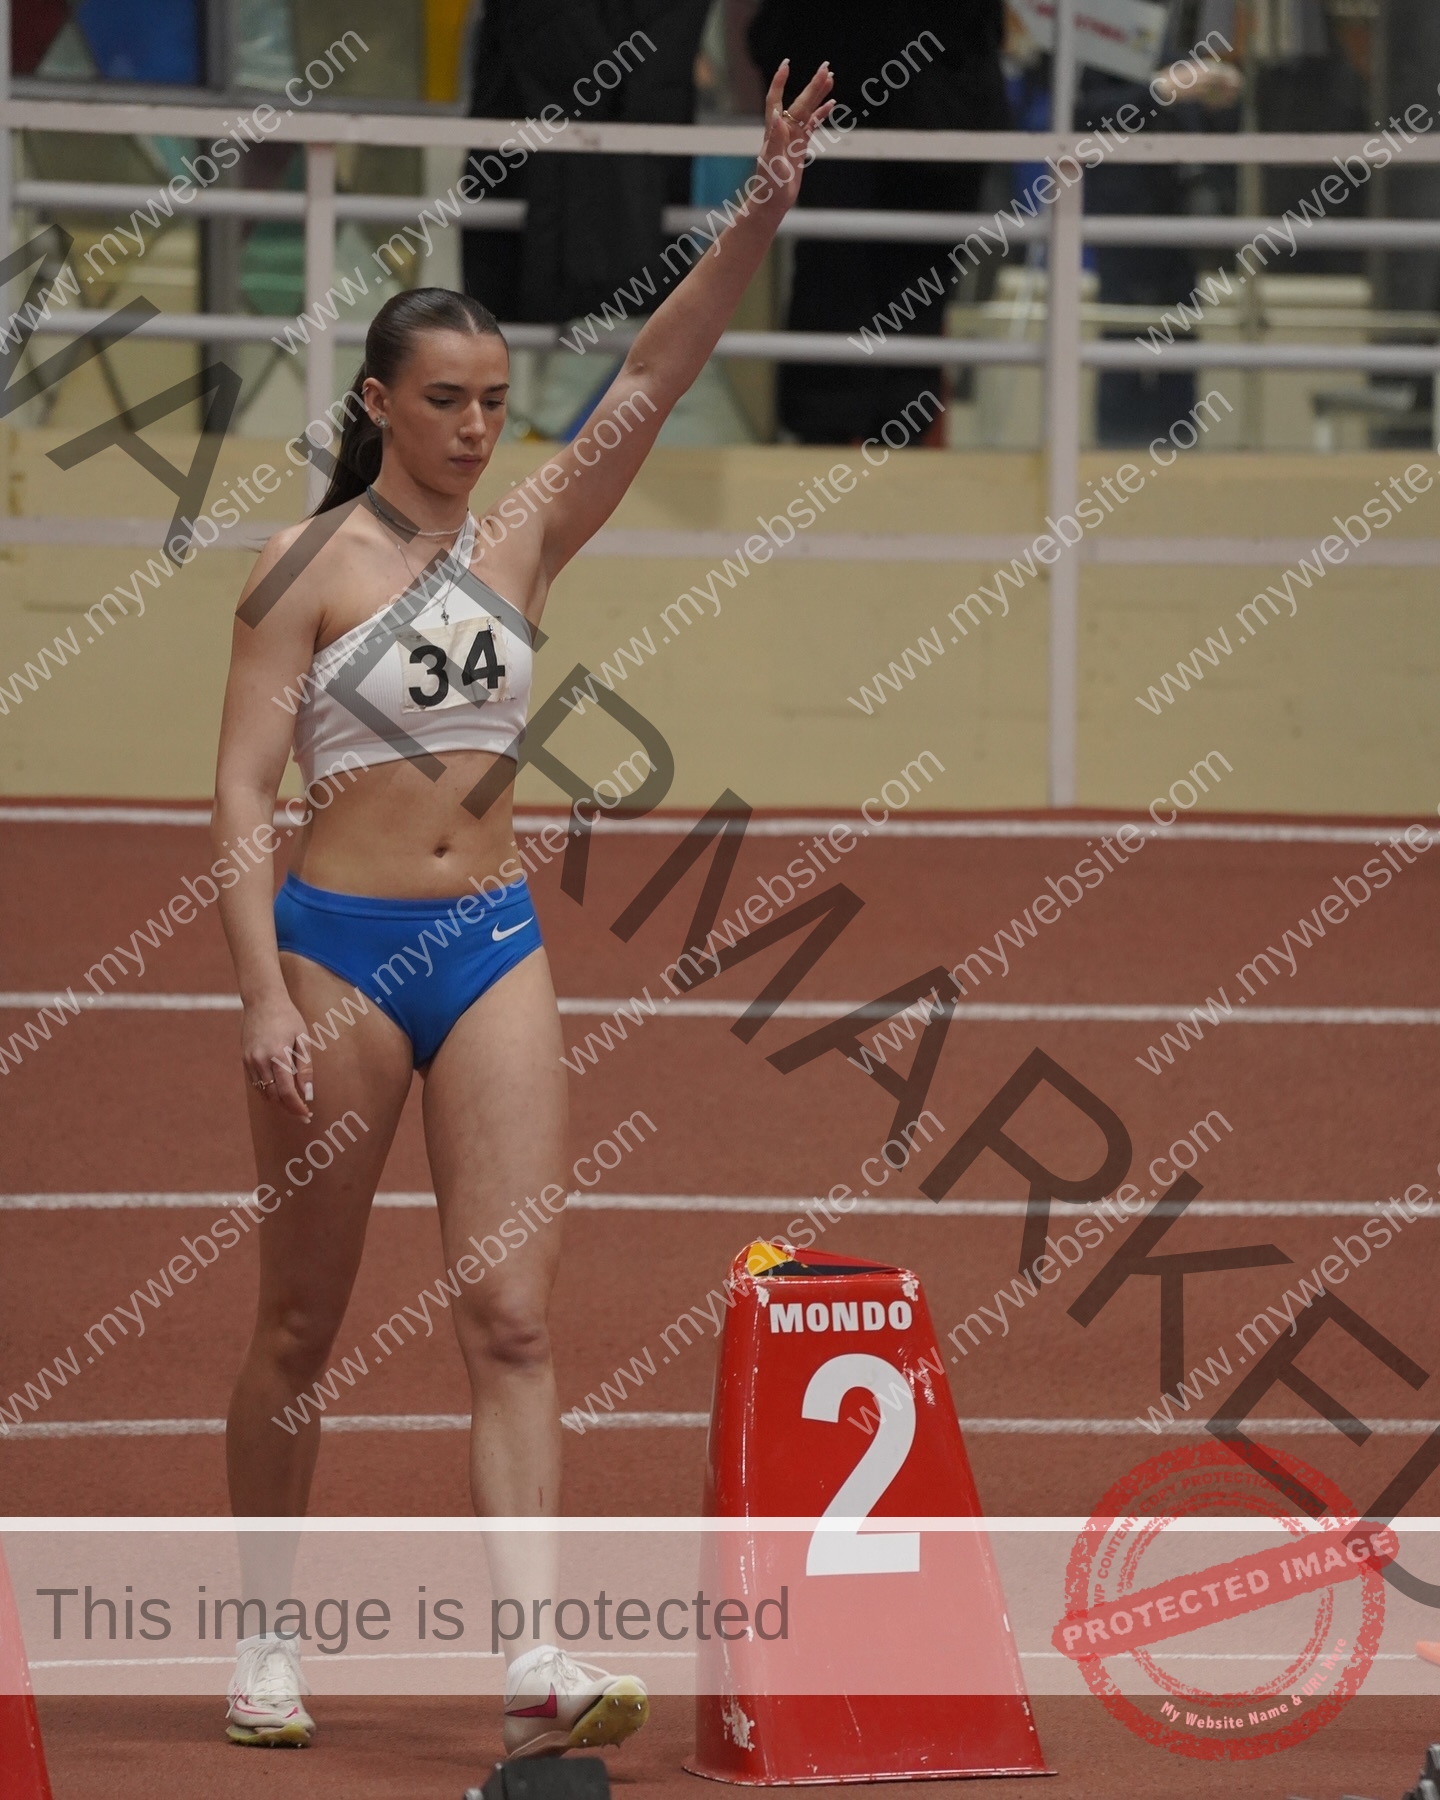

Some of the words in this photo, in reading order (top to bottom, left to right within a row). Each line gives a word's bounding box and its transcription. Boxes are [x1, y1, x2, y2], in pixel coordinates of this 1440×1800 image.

[409, 630, 505, 707] 34
[769, 1301, 912, 1333] MONDO
[801, 1353, 920, 1576] 2
